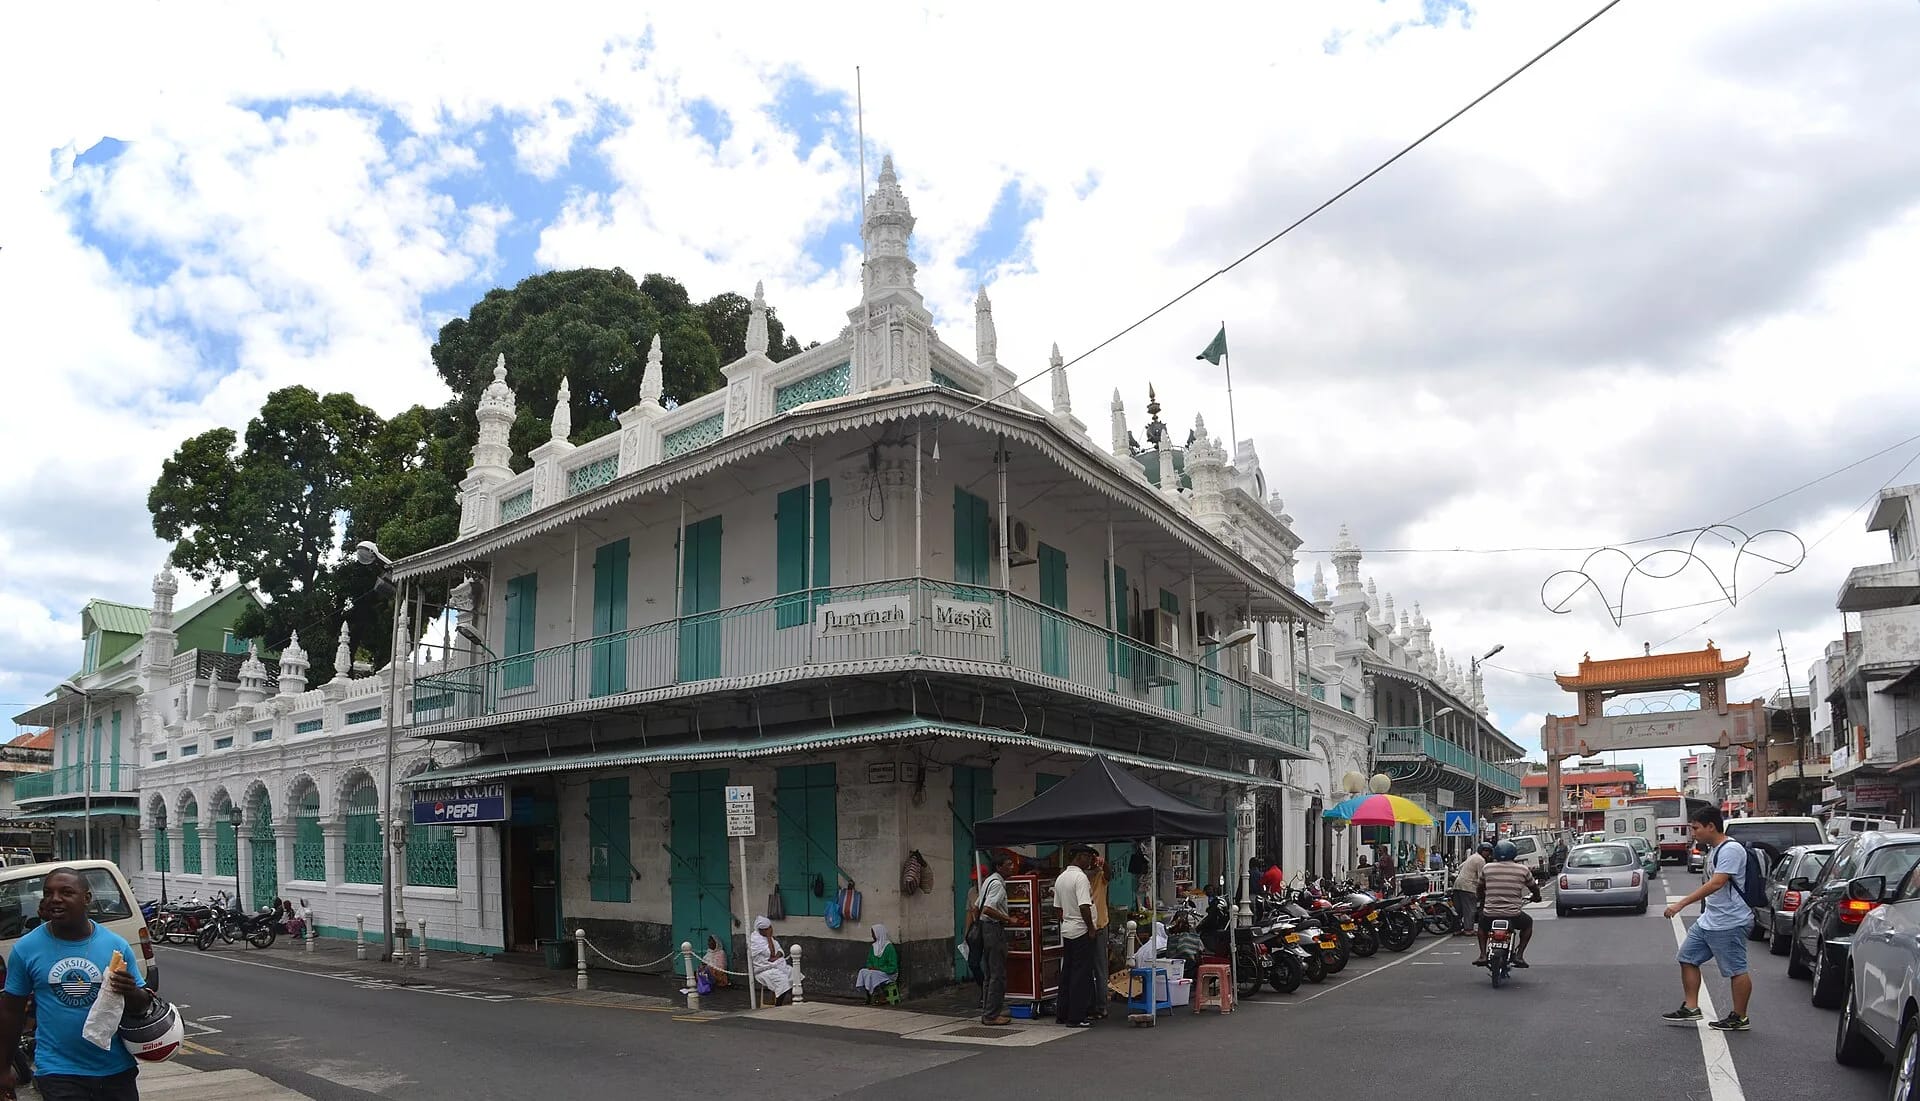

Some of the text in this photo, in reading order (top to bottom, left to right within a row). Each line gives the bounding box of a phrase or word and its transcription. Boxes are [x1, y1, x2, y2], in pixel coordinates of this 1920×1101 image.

[822, 604, 992, 633] Jummah Masjid
[730, 788, 737, 800] P
[445, 803, 479, 819] PEPSI
[51, 959, 99, 978] QUIKSILVER
